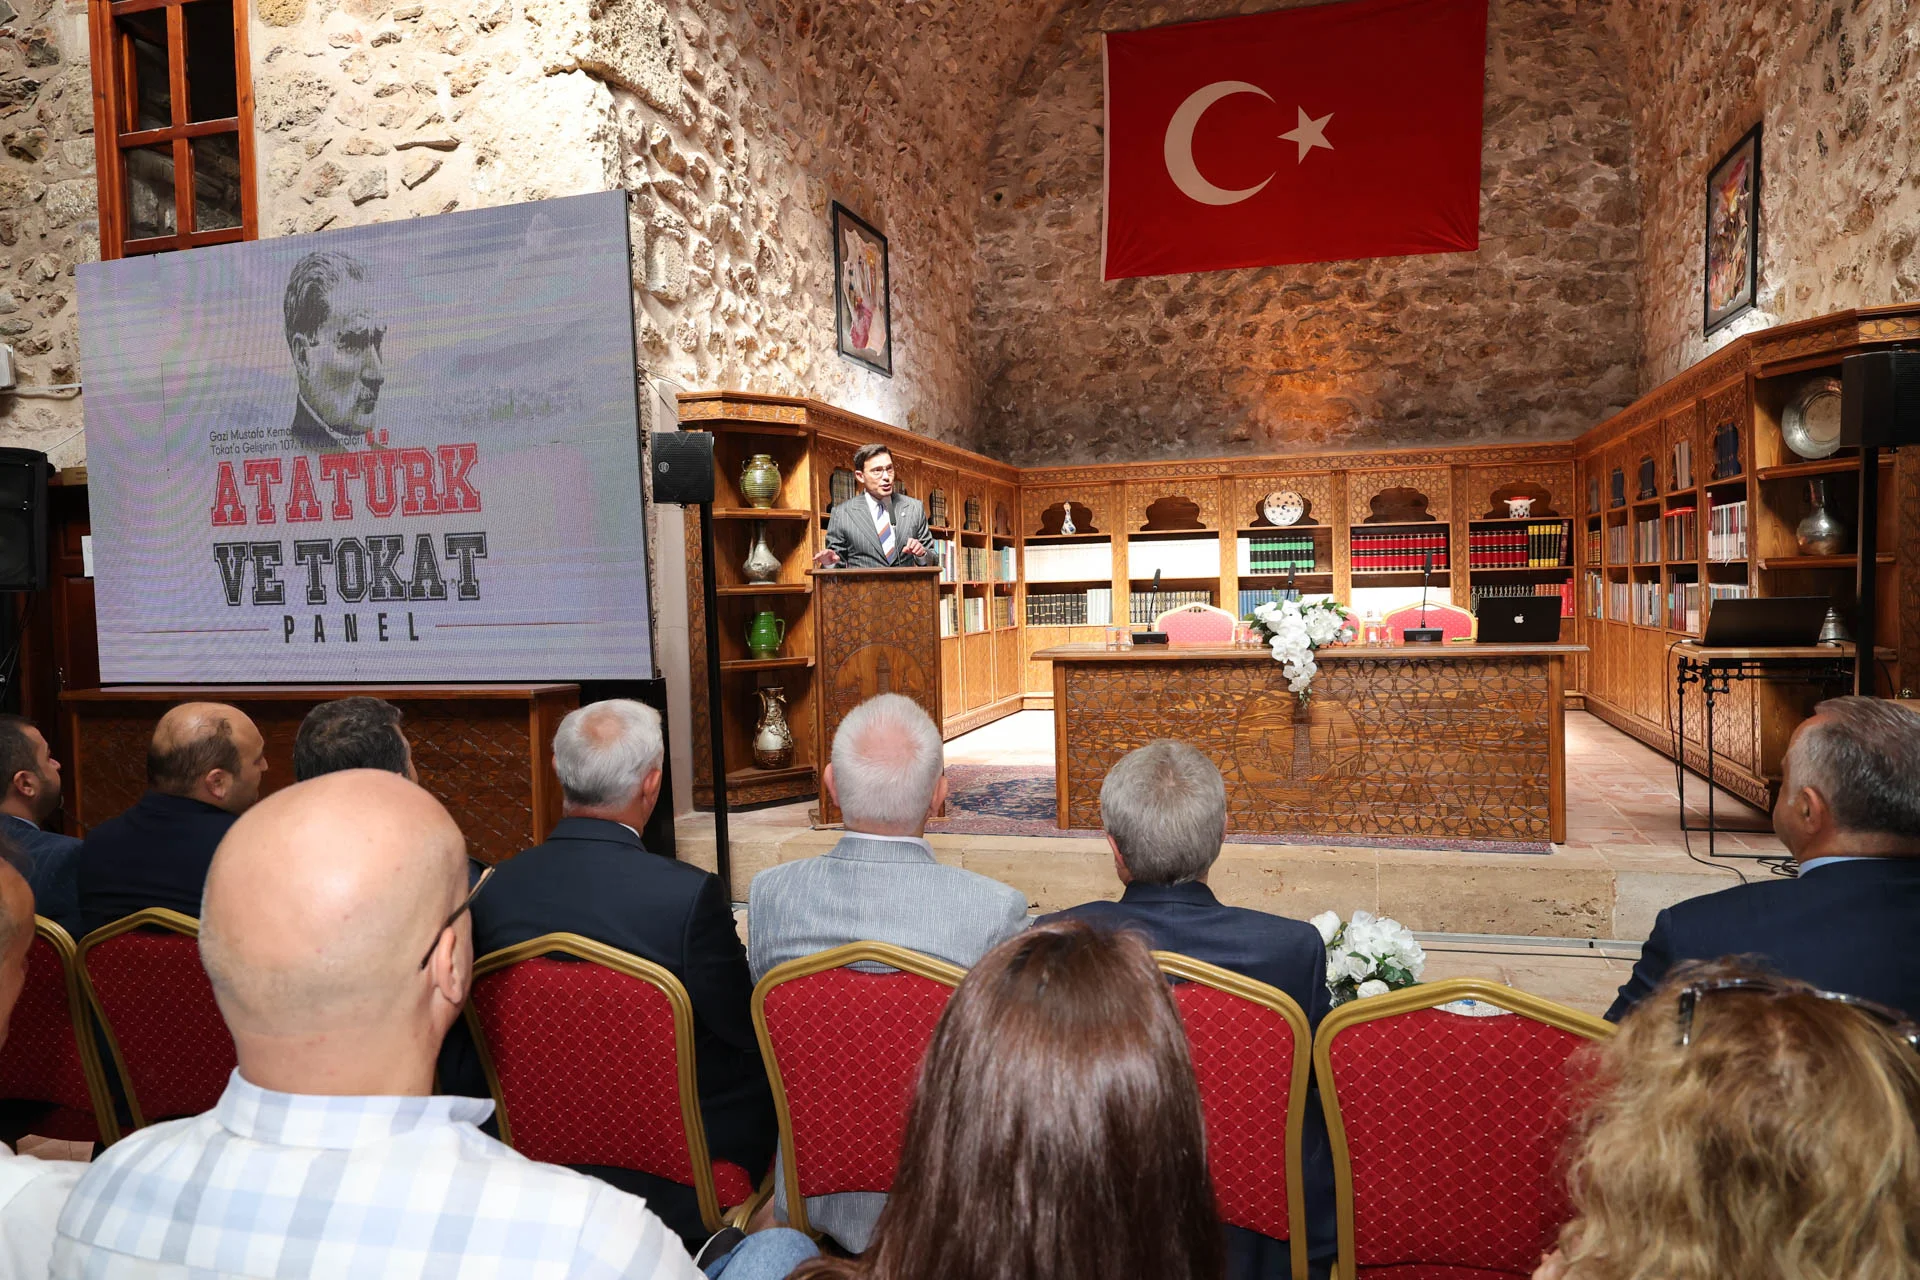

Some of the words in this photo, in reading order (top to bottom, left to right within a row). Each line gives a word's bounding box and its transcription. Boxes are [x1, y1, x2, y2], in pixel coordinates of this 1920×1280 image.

[209, 431, 229, 442] Gazi
[230, 428, 264, 441] Mustafa
[210, 443, 240, 456] Tokat'a
[242, 441, 278, 455] Gelişinin
[211, 428, 482, 526] ATATÜRK
[213, 540, 286, 606] VE
[294, 531, 488, 605] TOKAT
[283, 612, 420, 643] PANEL
